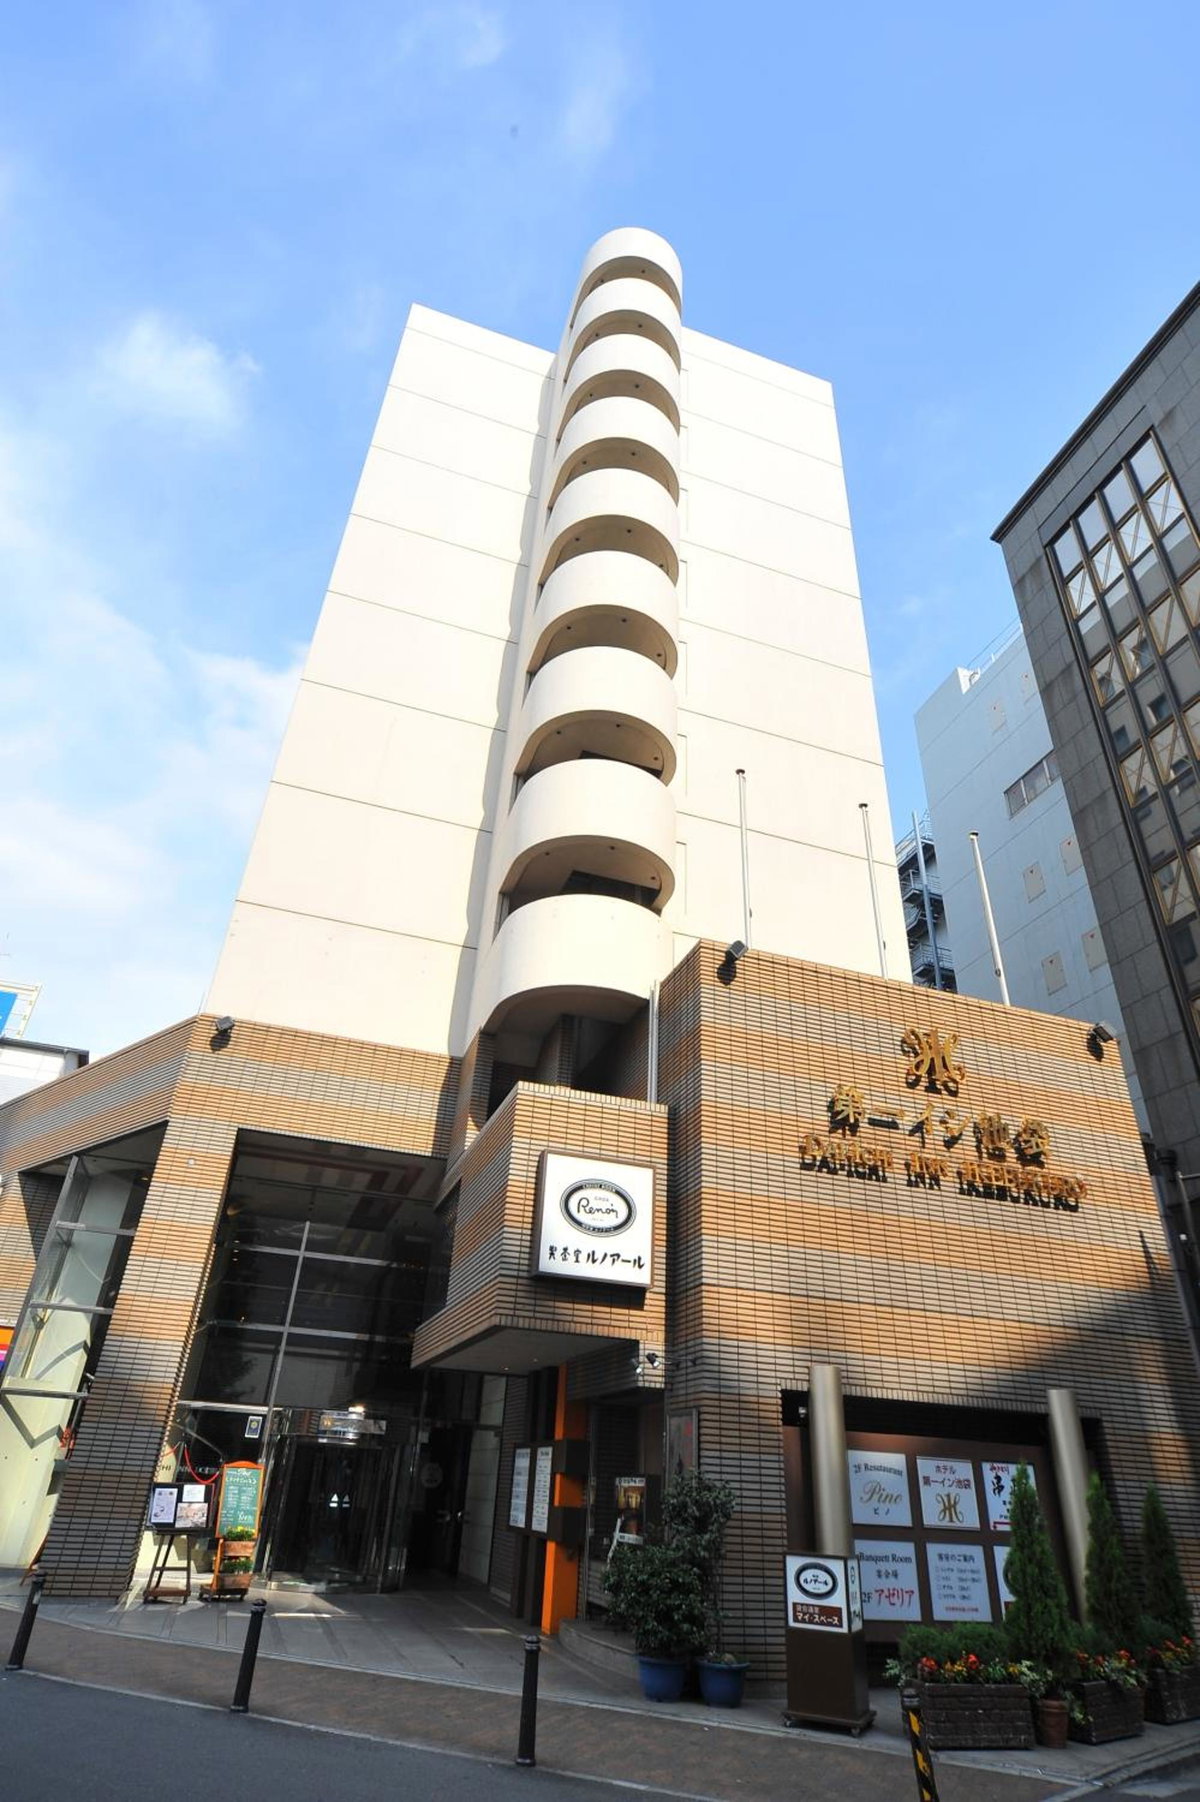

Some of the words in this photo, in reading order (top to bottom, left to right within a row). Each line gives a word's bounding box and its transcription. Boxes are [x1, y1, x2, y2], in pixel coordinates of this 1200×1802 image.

[860, 1480, 903, 1505] Pino
[891, 1553, 913, 1564] Room
[874, 1587, 915, 1608] アゼリア
